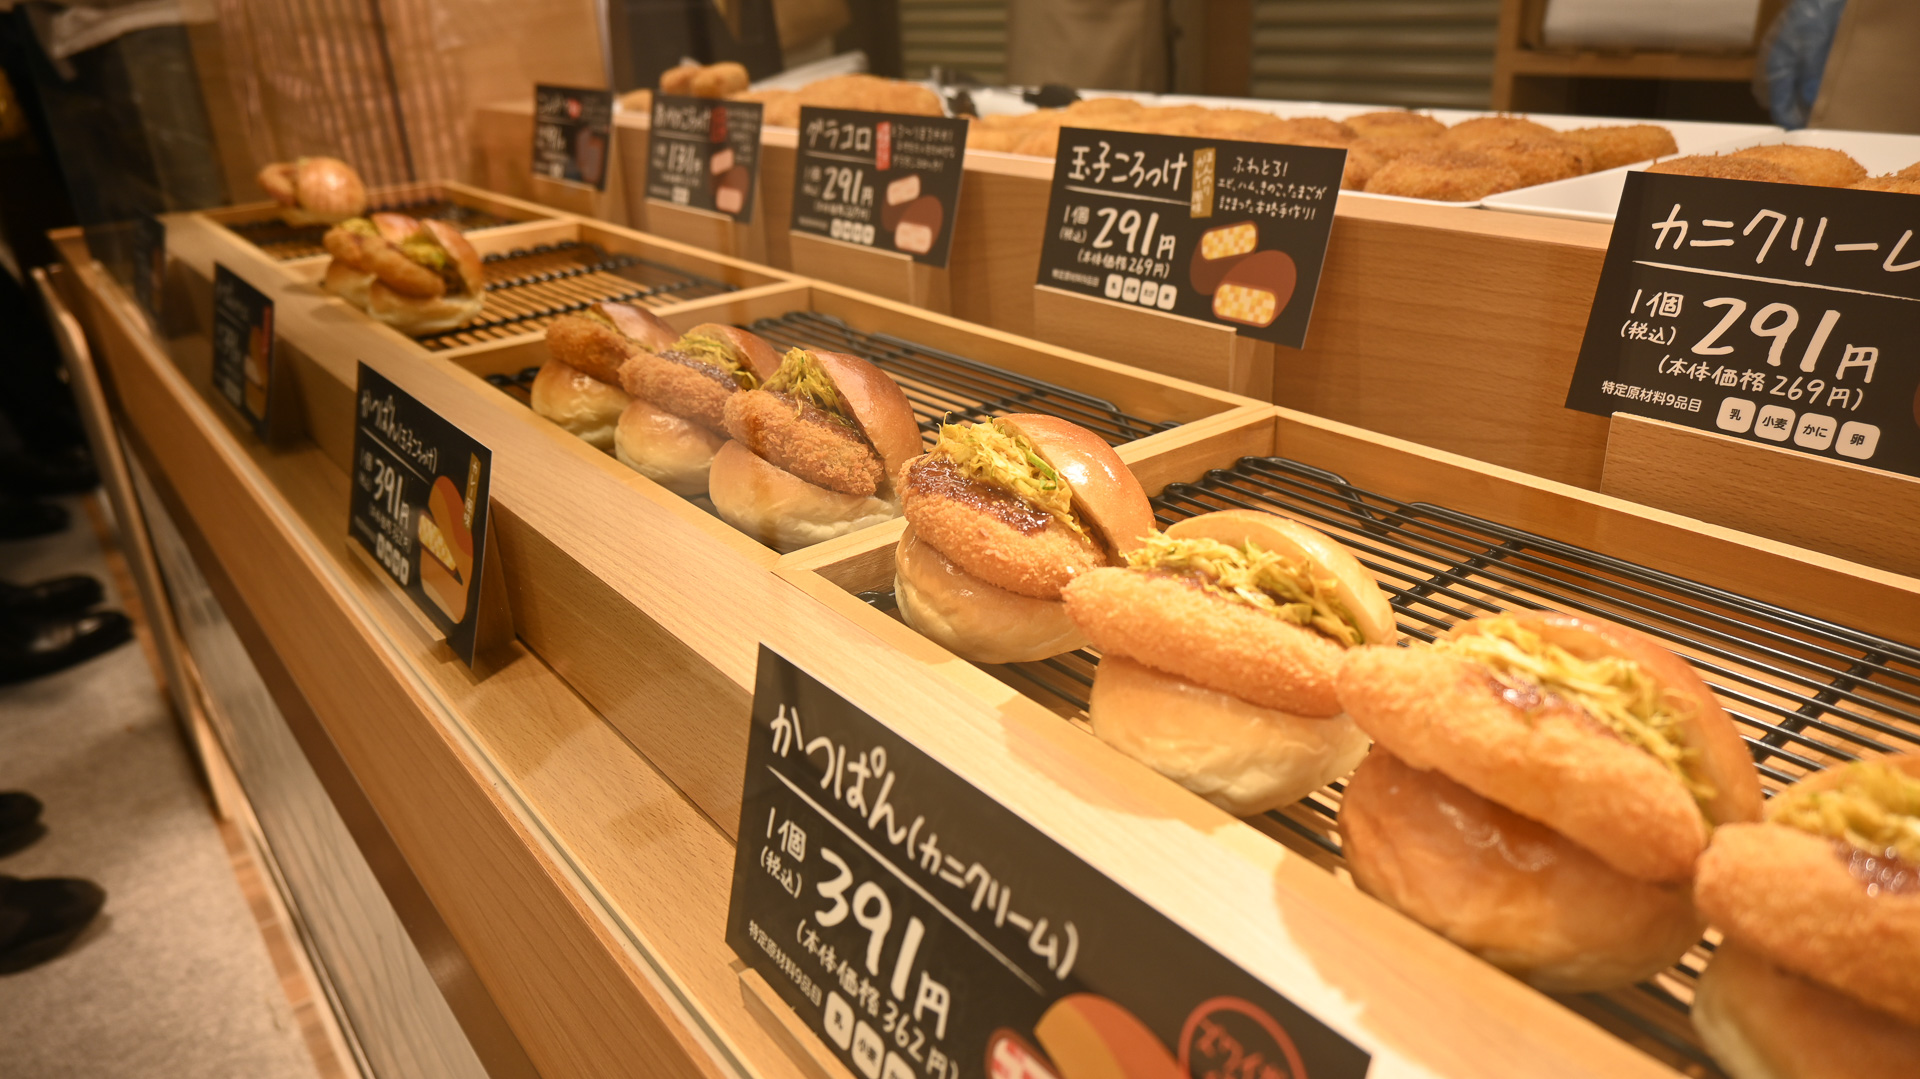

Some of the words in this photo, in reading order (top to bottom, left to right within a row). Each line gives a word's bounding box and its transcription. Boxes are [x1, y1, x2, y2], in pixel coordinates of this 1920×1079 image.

[805, 116, 872, 152] グラコロ
[822, 166, 874, 208] 291円
[1067, 141, 1188, 191] 玉子ころっけ
[1063, 204, 1090, 226] 1個
[1092, 207, 1176, 262] 291円
[1629, 288, 1684, 318] 1個
[1620, 319, 1677, 346] (税込)
[1690, 296, 1879, 384] 291円
[1601, 379, 1703, 413] 特定原材料9品目
[1657, 353, 1866, 412] (本体価格269円)
[1730, 408, 1742, 421] 乳
[1762, 415, 1787, 430] 小麦
[1802, 424, 1828, 438] かに
[1849, 433, 1865, 446] 卵
[373, 458, 410, 531] 391円
[766, 806, 807, 863] 1個
[768, 701, 1081, 981] かつぱん(カニクリーム)
[760, 847, 804, 901] (税込)
[747, 918, 823, 1008] 特定原材料9品目
[815, 845, 951, 1041] 391円
